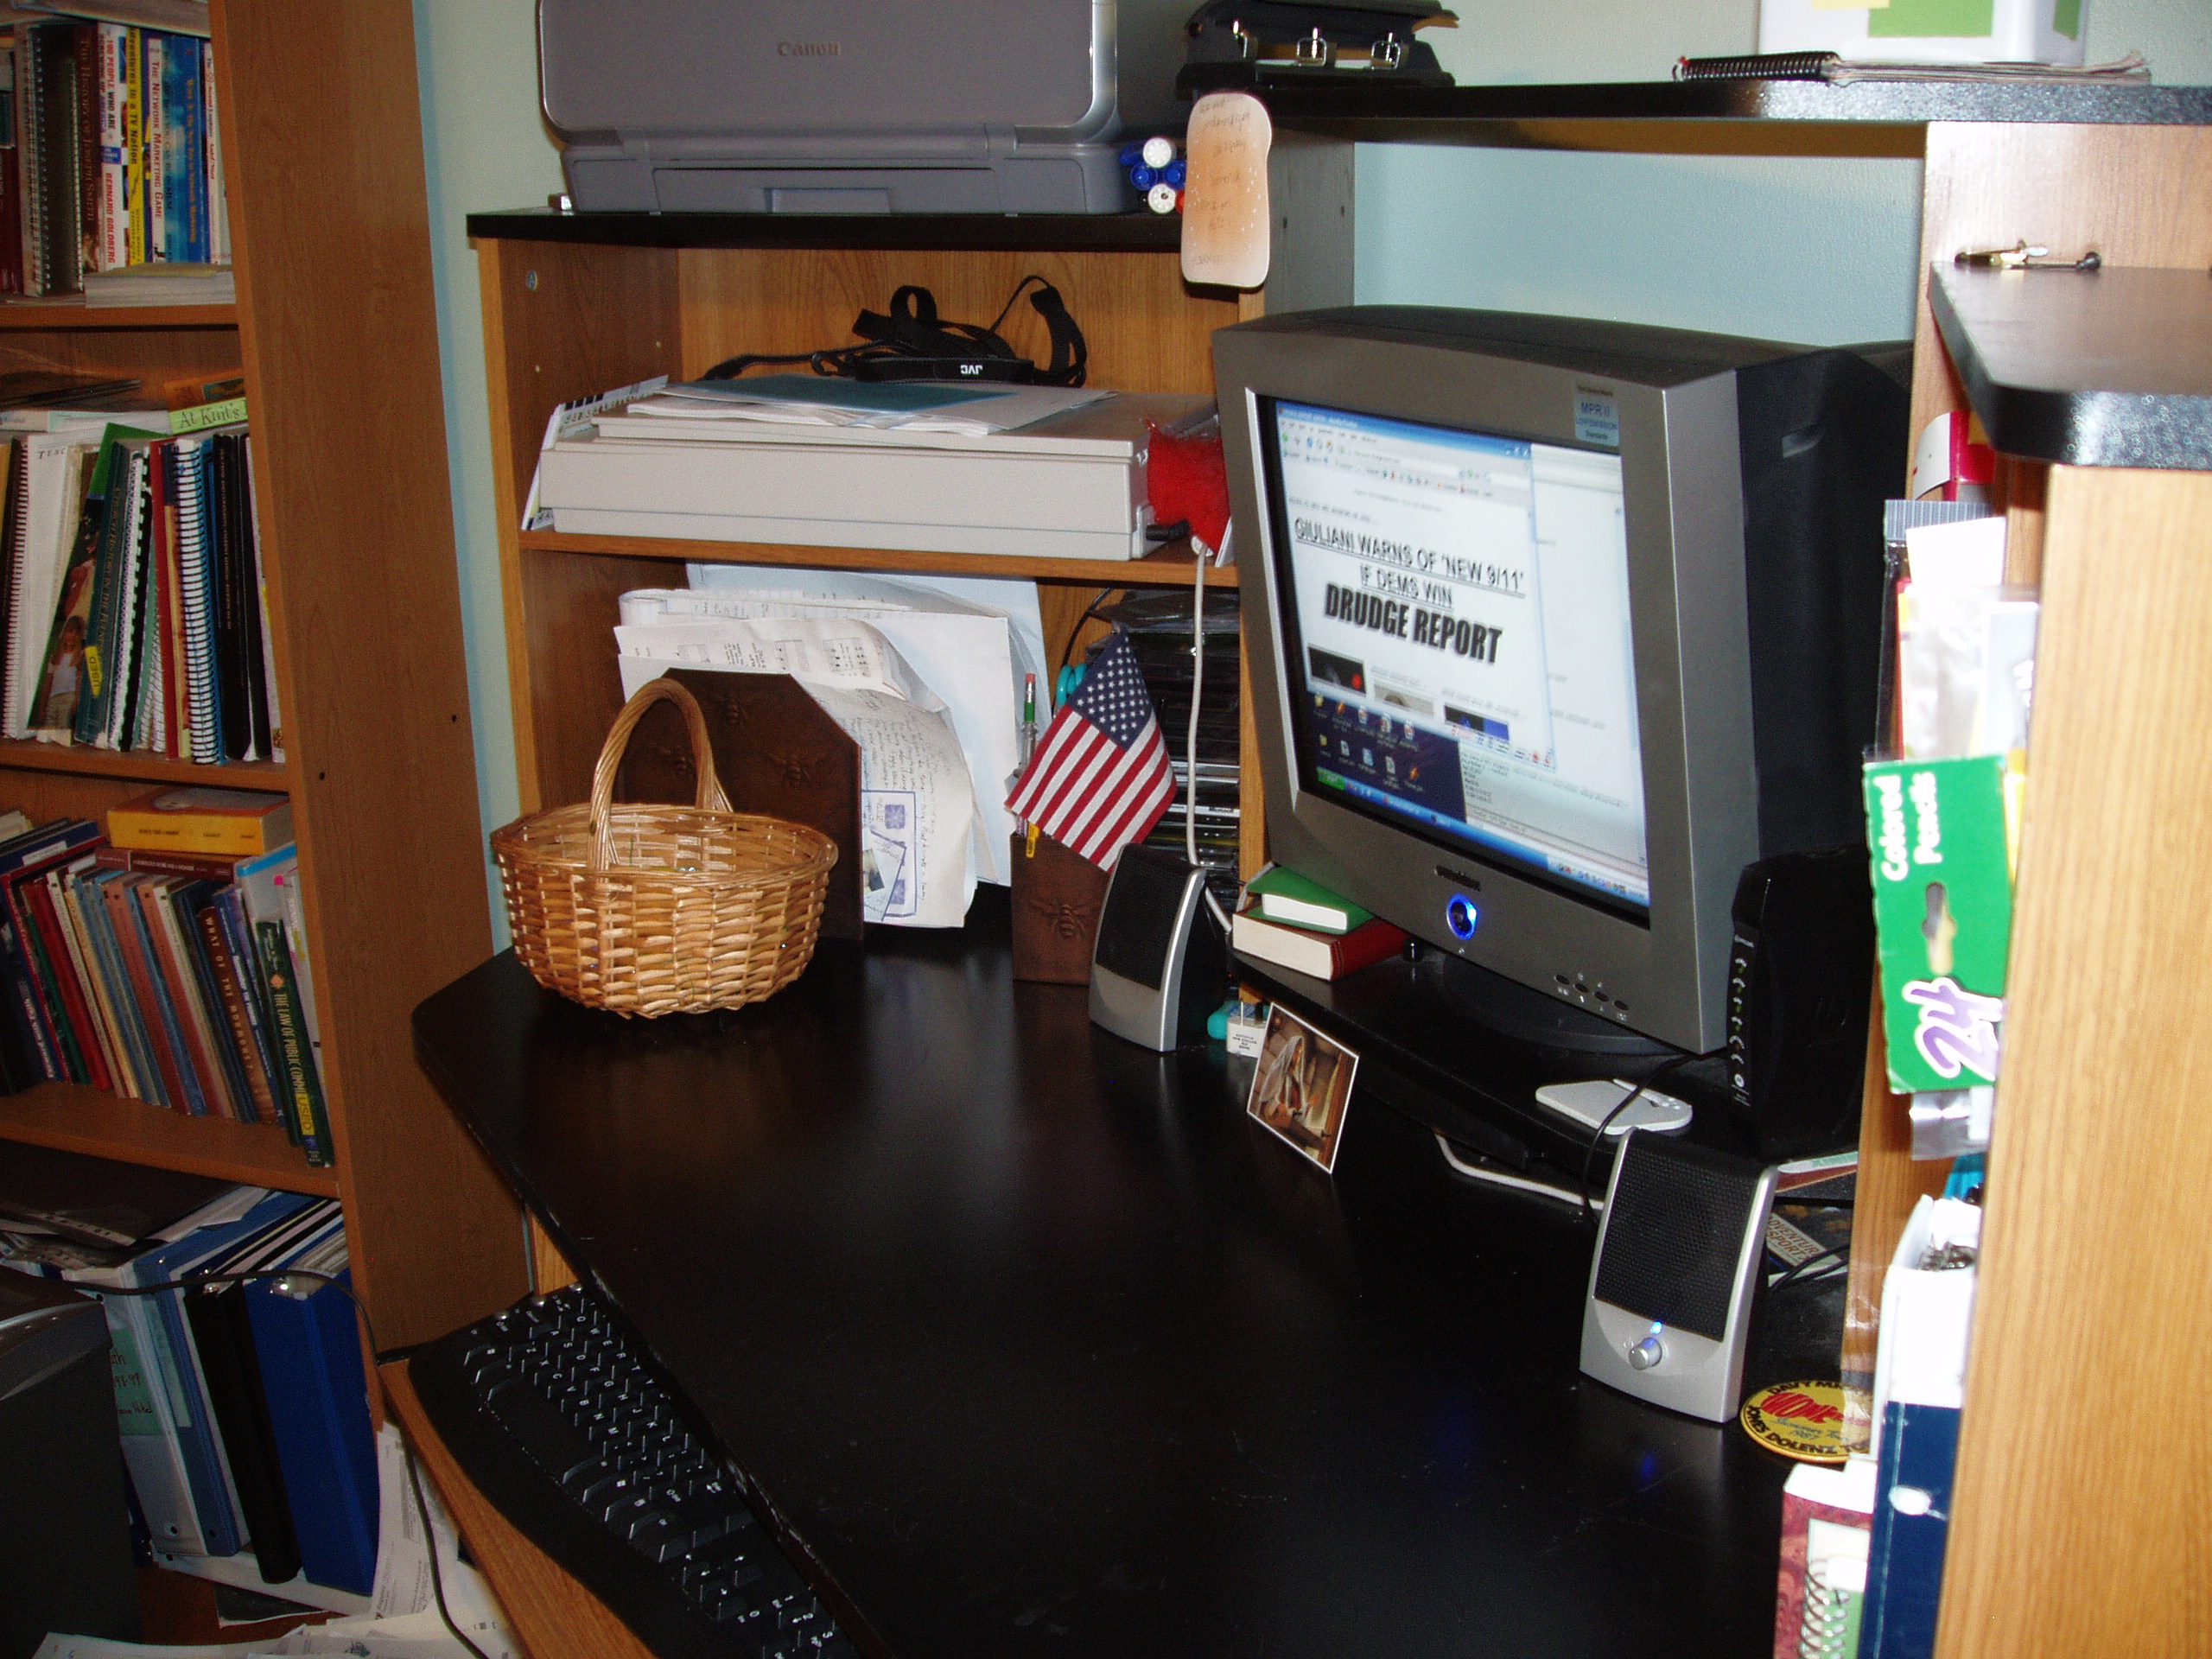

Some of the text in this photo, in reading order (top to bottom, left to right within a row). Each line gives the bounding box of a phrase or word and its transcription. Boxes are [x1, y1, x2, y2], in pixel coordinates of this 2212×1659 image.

[778, 41, 842, 56] Canon
[130, 114, 138, 126] TV
[152, 82, 161, 129] NETWORK
[154, 133, 162, 188] MARKETING
[105, 172, 114, 215] BERNARD
[155, 192, 164, 219] GAME
[960, 364, 983, 375] JVC
[180, 410, 196, 429] At
[1581, 401, 1603, 416] MPR
[1294, 518, 1355, 552] GIULIANI
[1357, 532, 1414, 568] WARNS
[1417, 548, 1437, 573] OF
[1360, 563, 1454, 607] IF DEMS WIN
[1325, 581, 1503, 664] DRUDGE REPORT
[89, 657, 101, 687] USED
[1873, 774, 1910, 882] Colored
[1909, 771, 1944, 865] Pencils
[205, 917, 220, 947] WHAT
[214, 955, 226, 969] OF
[220, 977, 233, 998] THE
[273, 993, 289, 1008] THE
[275, 1007, 292, 1027] LAW
[281, 1027, 294, 1038] OF
[1902, 976, 2006, 1083] 24
[283, 1038, 301, 1065] PUBLIC
[297, 1096, 313, 1131] USED
[1746, 1405, 1770, 1434] JONES
[1764, 1432, 1838, 1455] DOLENZ
